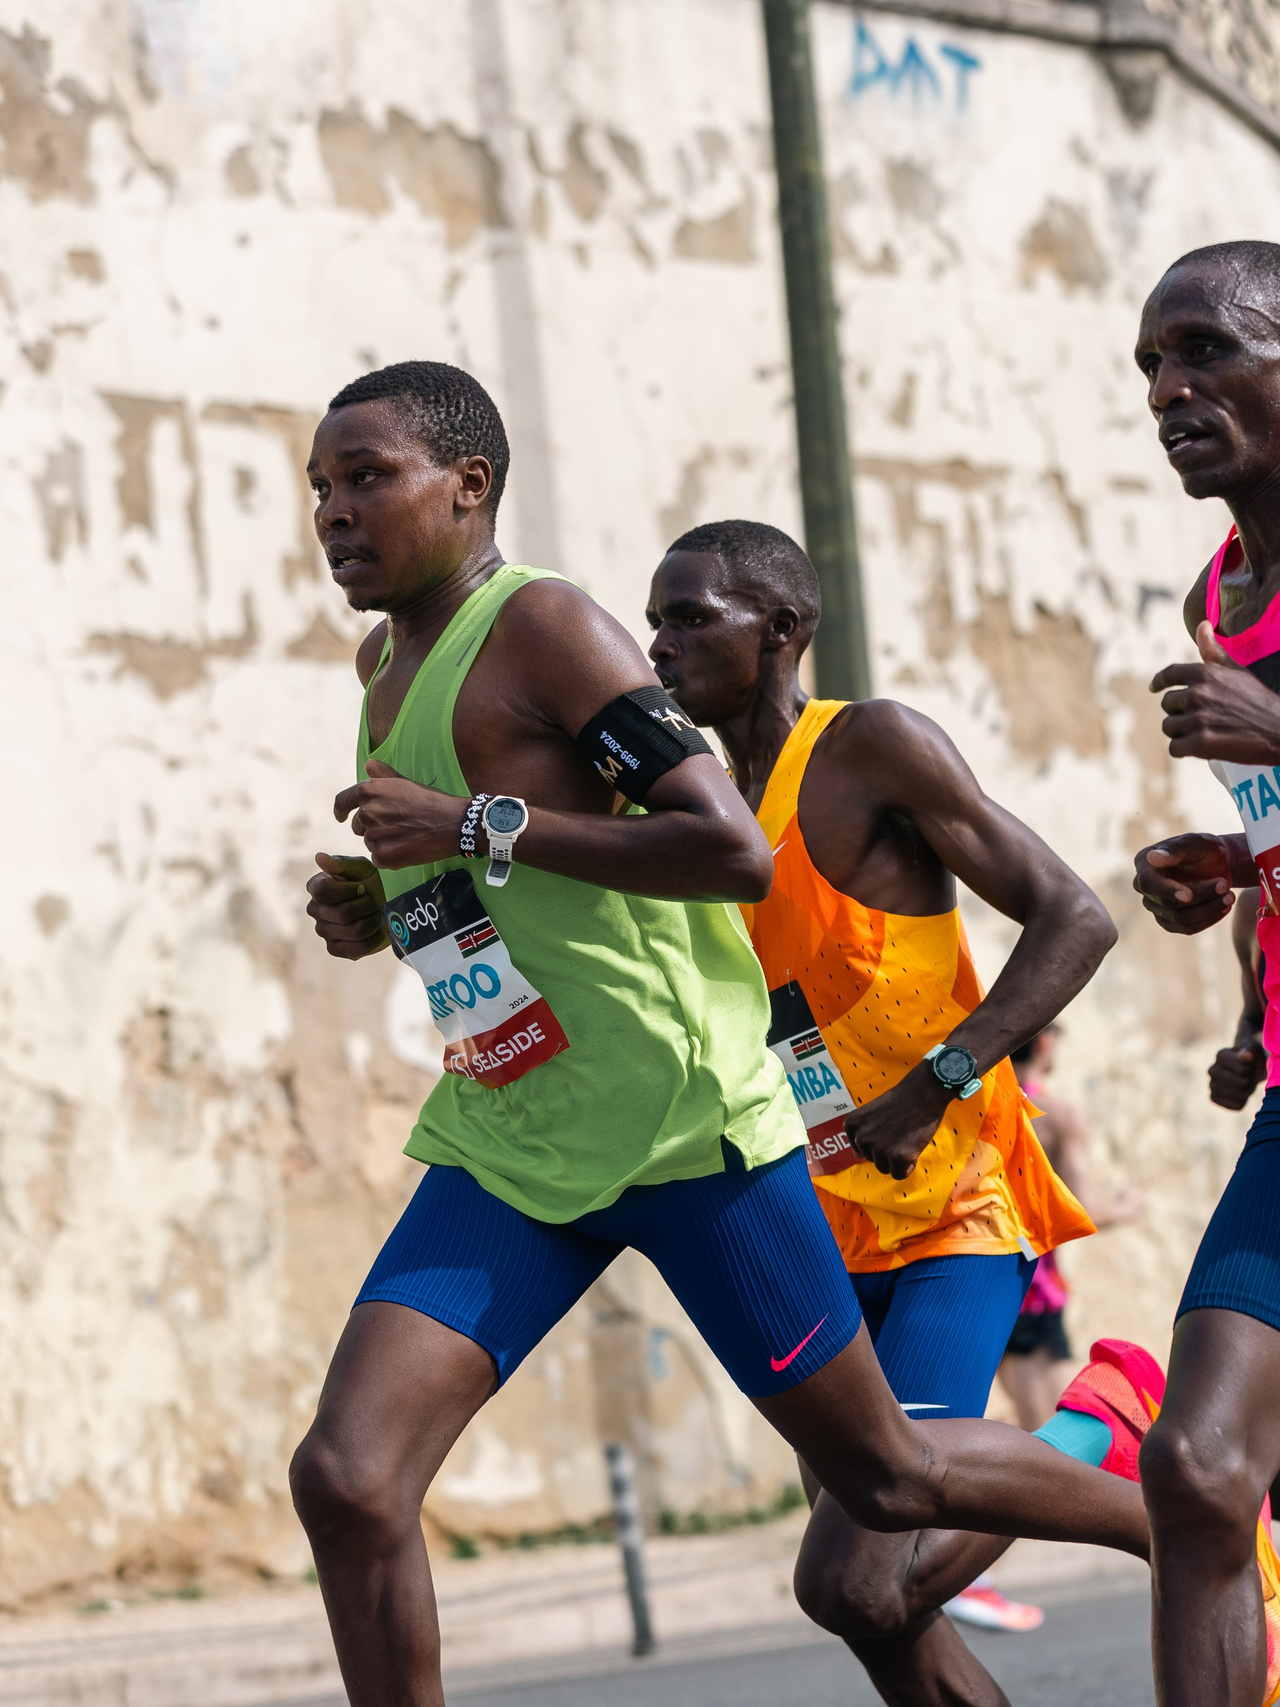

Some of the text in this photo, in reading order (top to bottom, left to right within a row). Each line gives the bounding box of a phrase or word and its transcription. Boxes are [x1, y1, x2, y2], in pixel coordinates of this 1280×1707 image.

[600, 730, 640, 770] 1999-2024
[405, 897, 439, 931] edp
[509, 994, 529, 1010] 2024
[472, 1022, 545, 1073] SEASIDE
